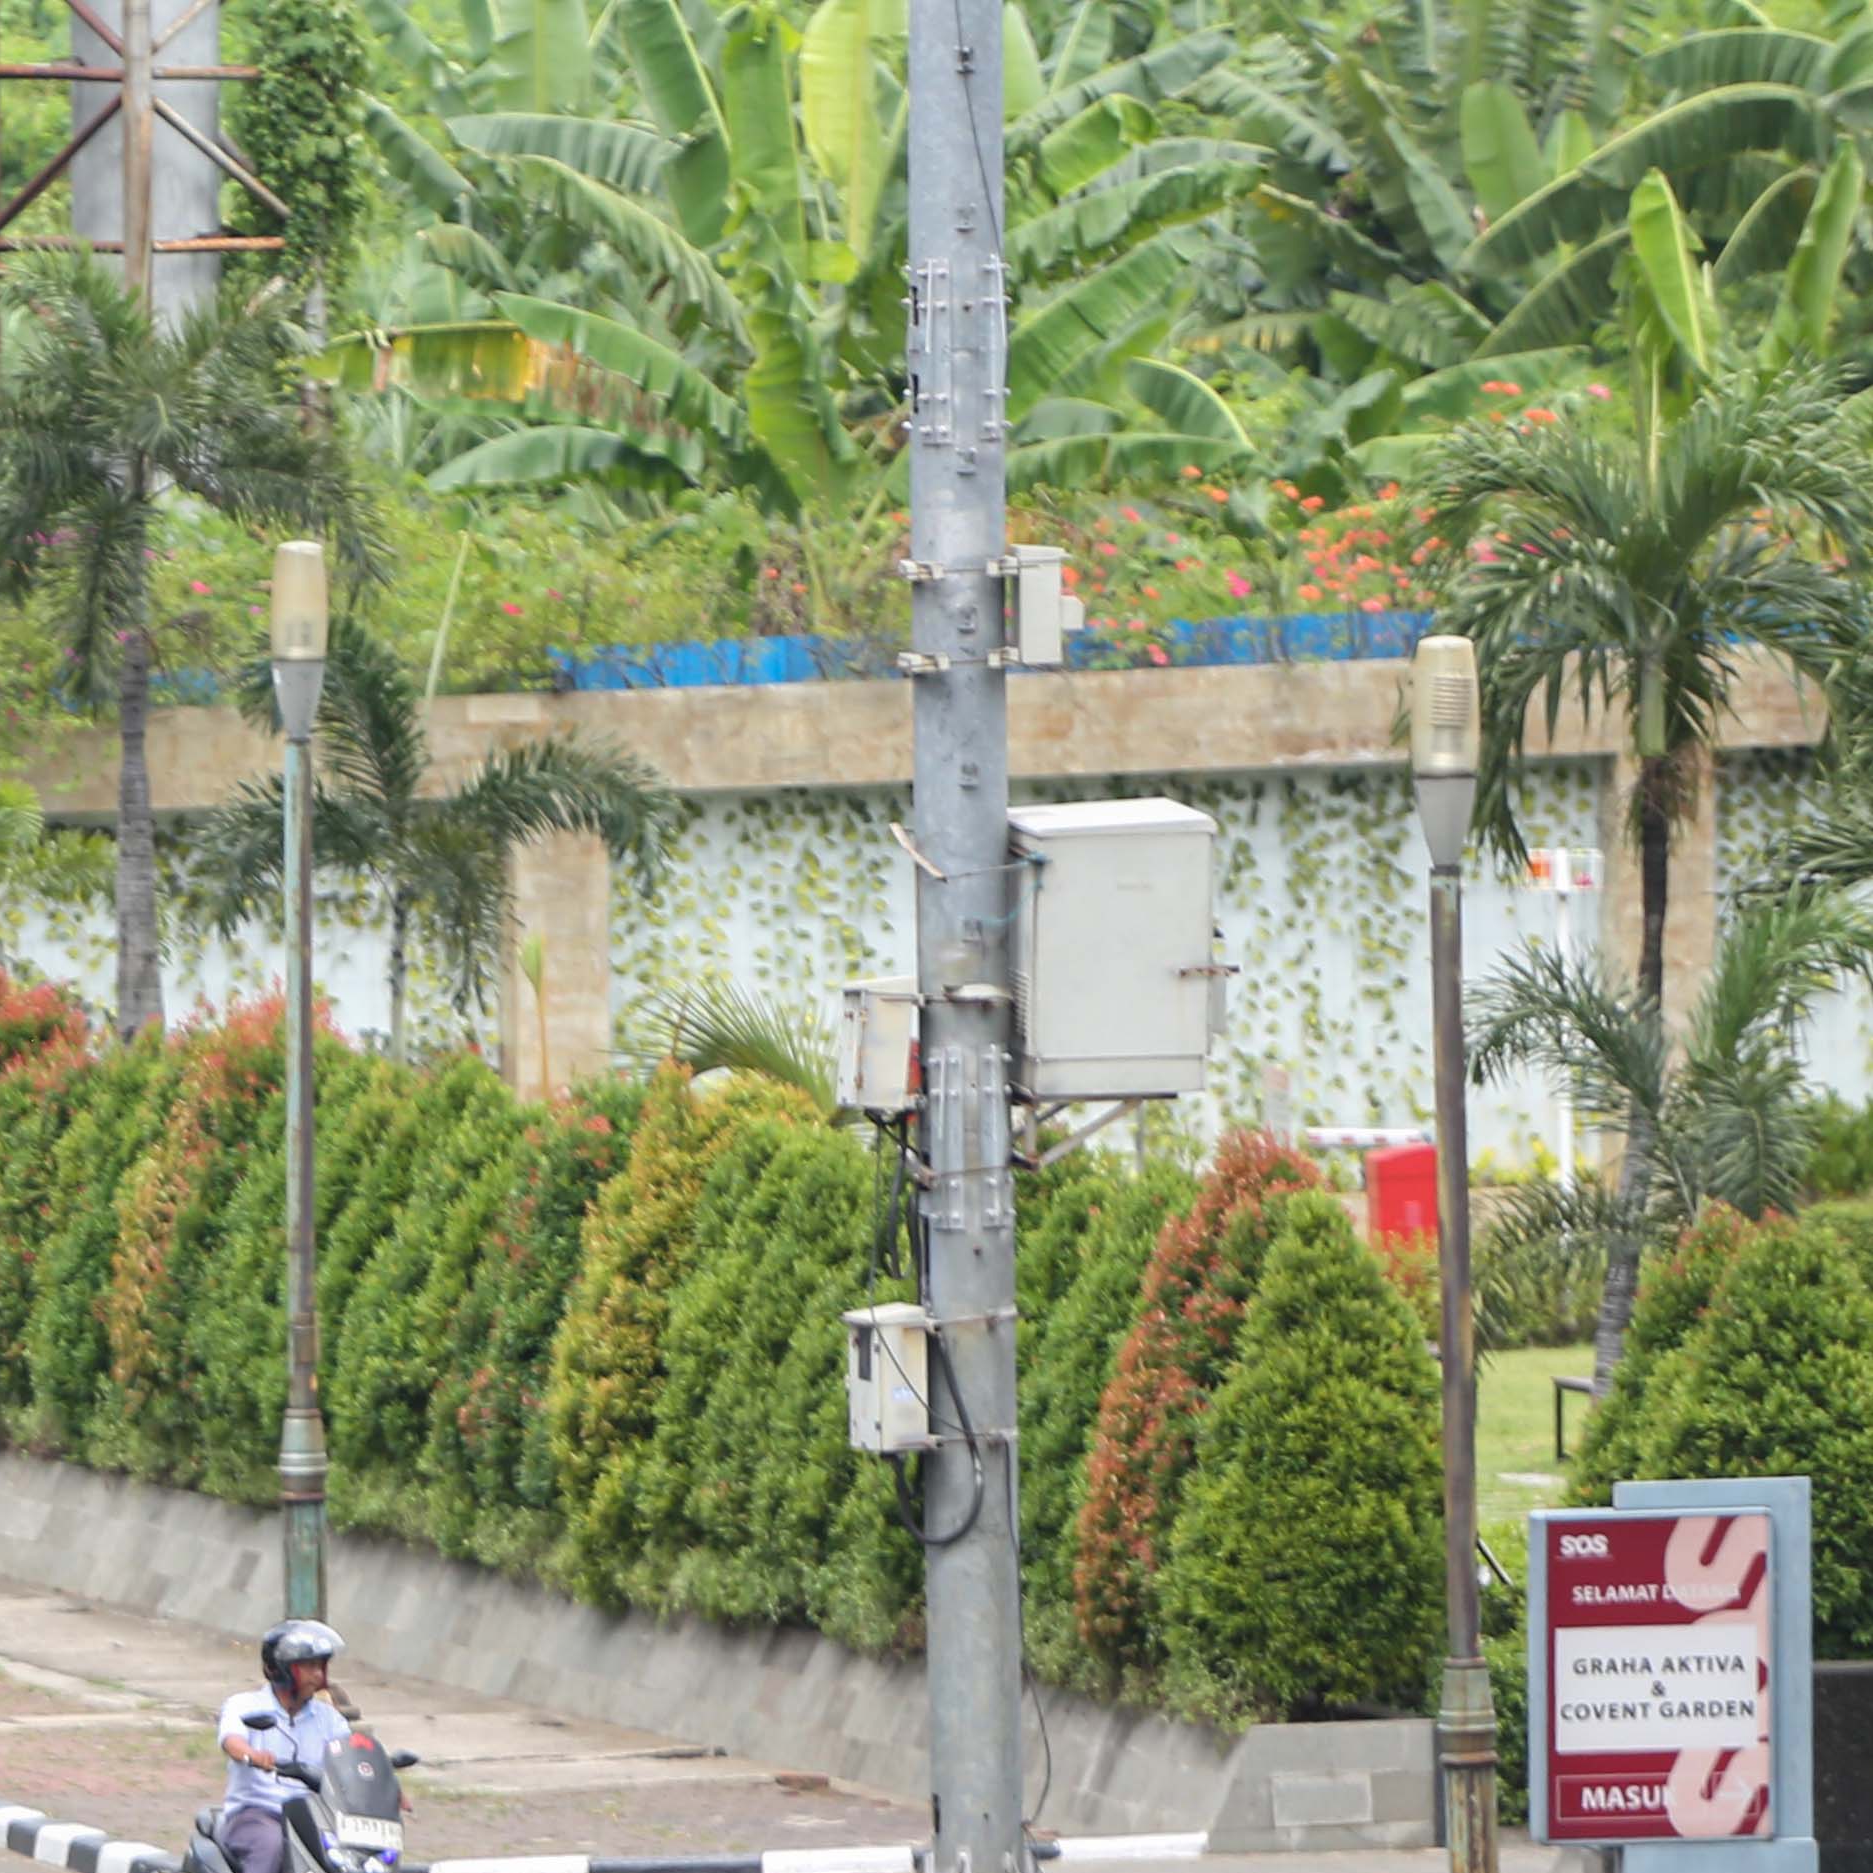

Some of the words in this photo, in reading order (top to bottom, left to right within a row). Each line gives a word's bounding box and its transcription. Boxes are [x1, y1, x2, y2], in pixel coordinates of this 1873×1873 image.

[1560, 1534, 1609, 1556] SOS
[1572, 1584, 1659, 1603] SELAMAT
[1572, 1657, 1653, 1676] GRAHA
[1661, 1655, 1745, 1674] AKTIVA
[1650, 1680, 1667, 1697] &
[1559, 1702, 1651, 1721] COVENT
[1658, 1700, 1754, 1719] GARDEN
